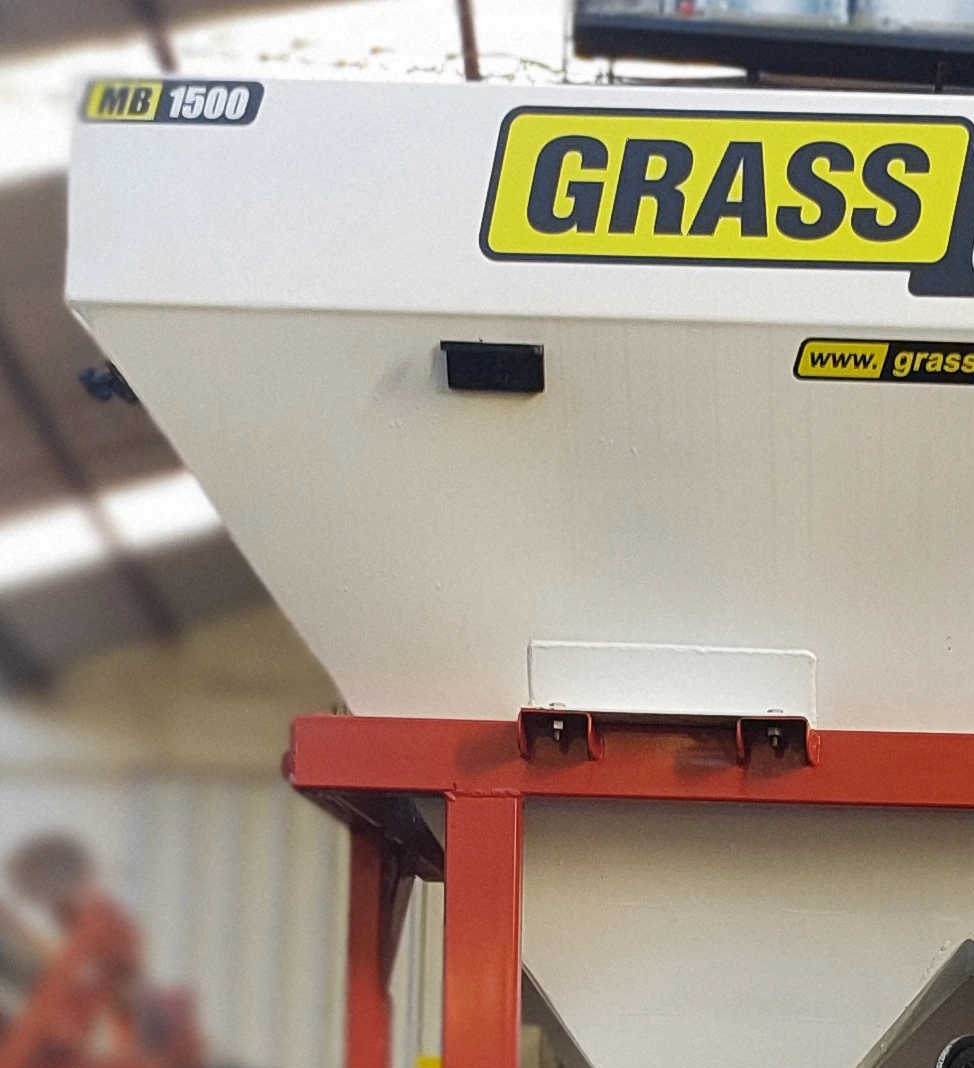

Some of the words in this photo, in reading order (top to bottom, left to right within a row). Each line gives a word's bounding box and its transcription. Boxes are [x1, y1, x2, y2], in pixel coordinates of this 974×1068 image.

[98, 85, 154, 118] MB
[169, 86, 250, 120] 1500
[525, 134, 930, 243] GRASS
[810, 351, 879, 370] www.
